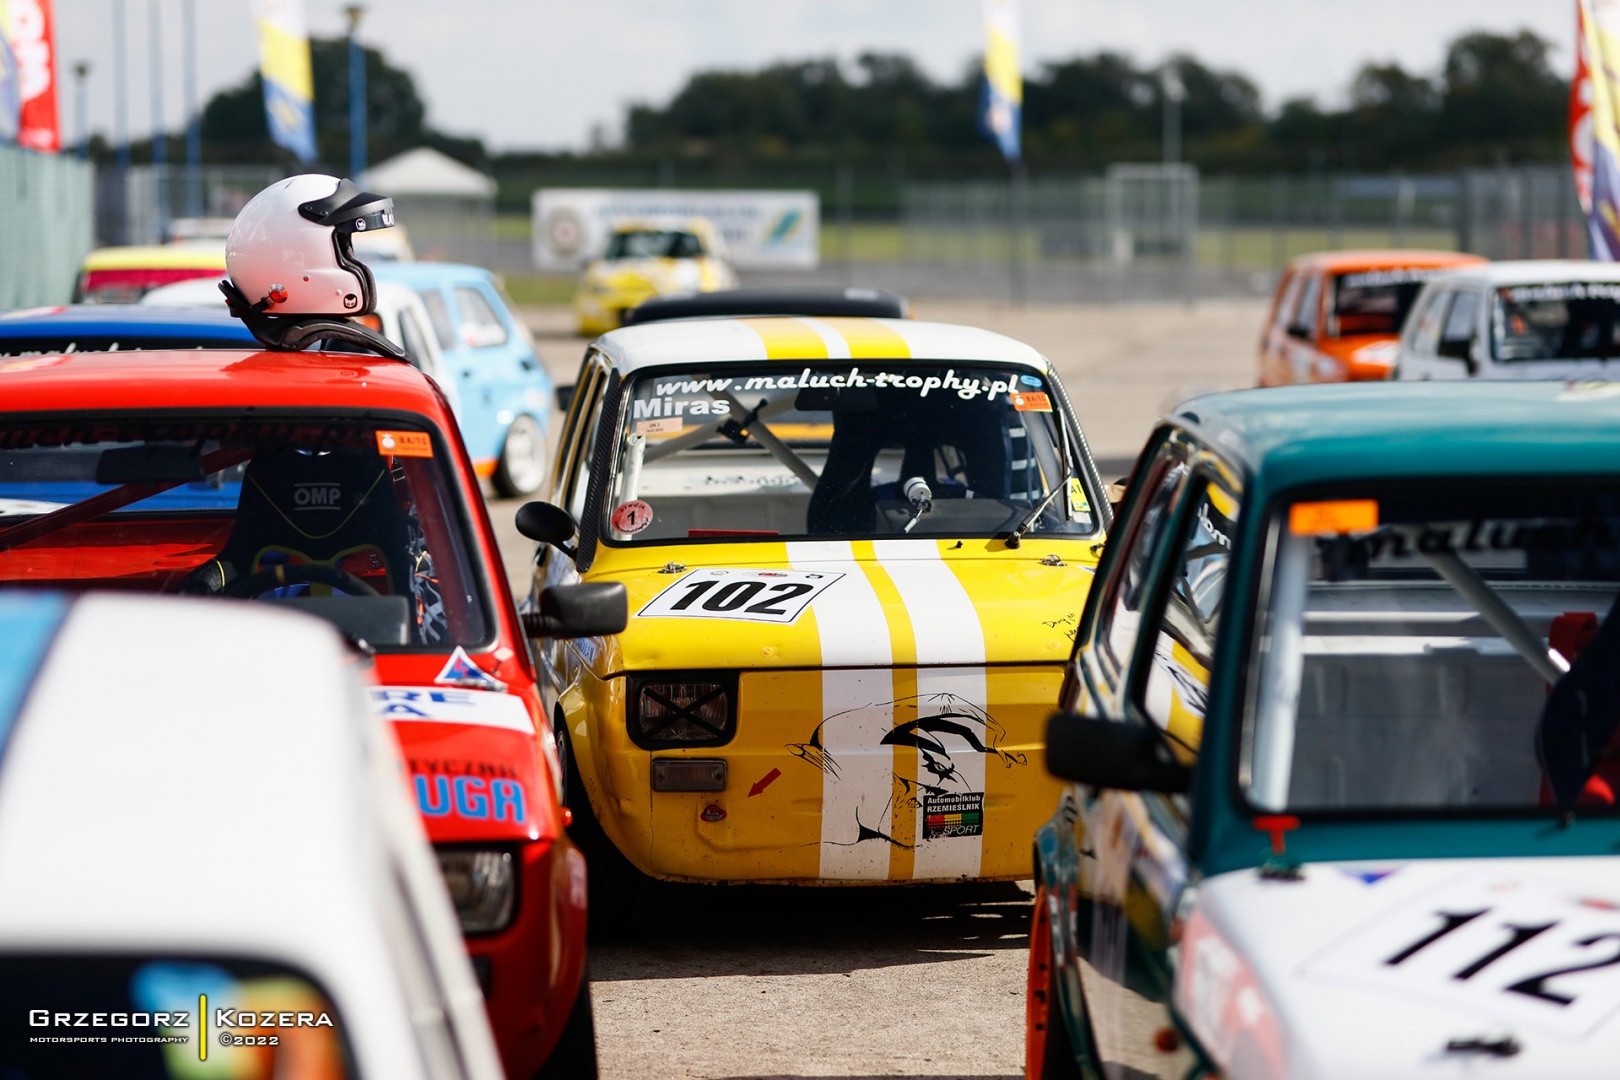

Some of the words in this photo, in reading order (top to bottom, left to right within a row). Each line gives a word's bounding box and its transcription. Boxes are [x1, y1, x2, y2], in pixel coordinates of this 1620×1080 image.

[656, 368, 1018, 401] www.maluch-trophy.pl
[633, 398, 731, 419] Miras
[294, 487, 341, 506] OMP
[627, 510, 636, 526] 1
[669, 580, 815, 616] 102
[927, 795, 981, 804] Automobilklub
[943, 824, 980, 836] SPORT
[1380, 905, 1620, 1007] 112
